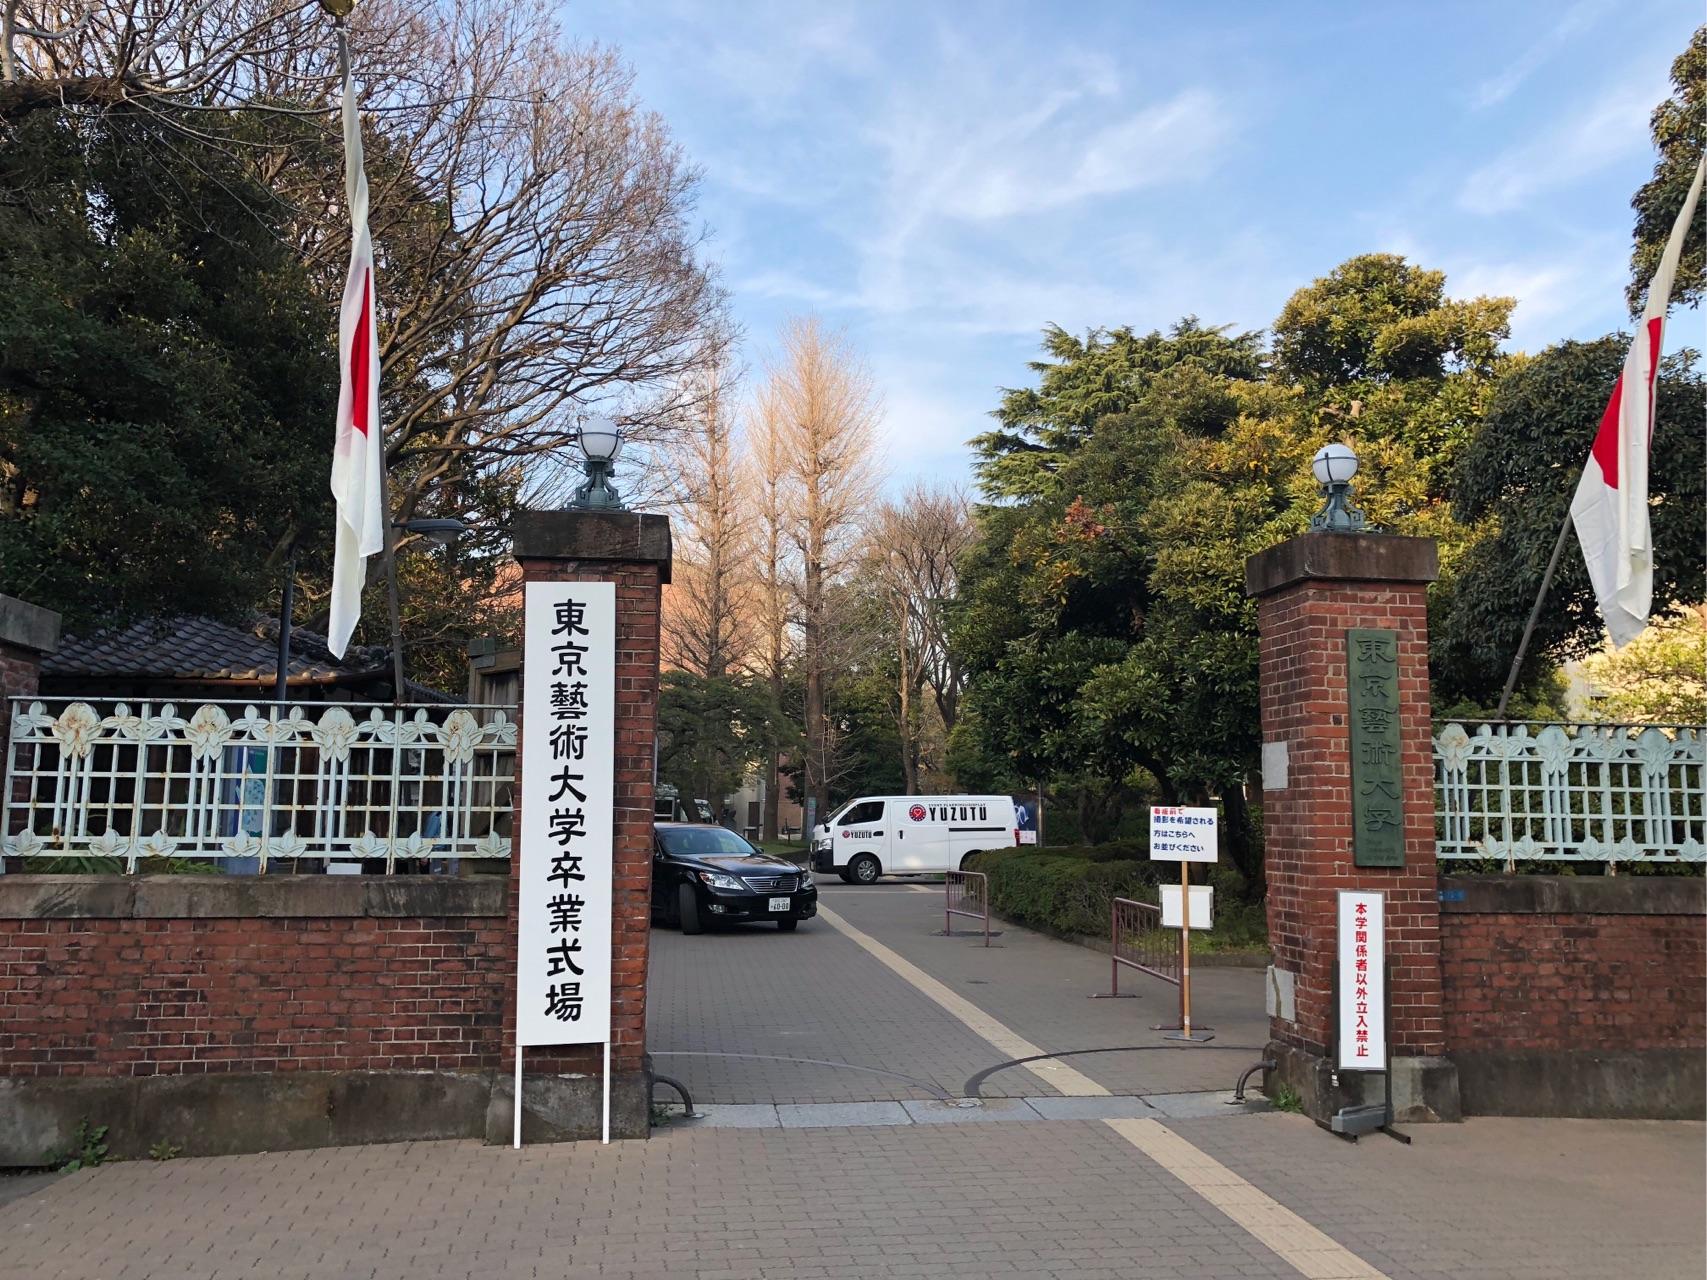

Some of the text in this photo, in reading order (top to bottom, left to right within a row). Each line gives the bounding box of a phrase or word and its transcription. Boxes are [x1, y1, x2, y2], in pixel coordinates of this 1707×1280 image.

[544, 598, 590, 1022] 東京藝術大学卒業式場
[929, 807, 987, 821] YUZUTU
[1153, 816, 1214, 825] 撮影を希望される
[1153, 830, 1195, 838] 方はこちらへ
[1153, 843, 1204, 852] お並びください
[1355, 903, 1369, 1057] 本学関係者以外立入禁止
